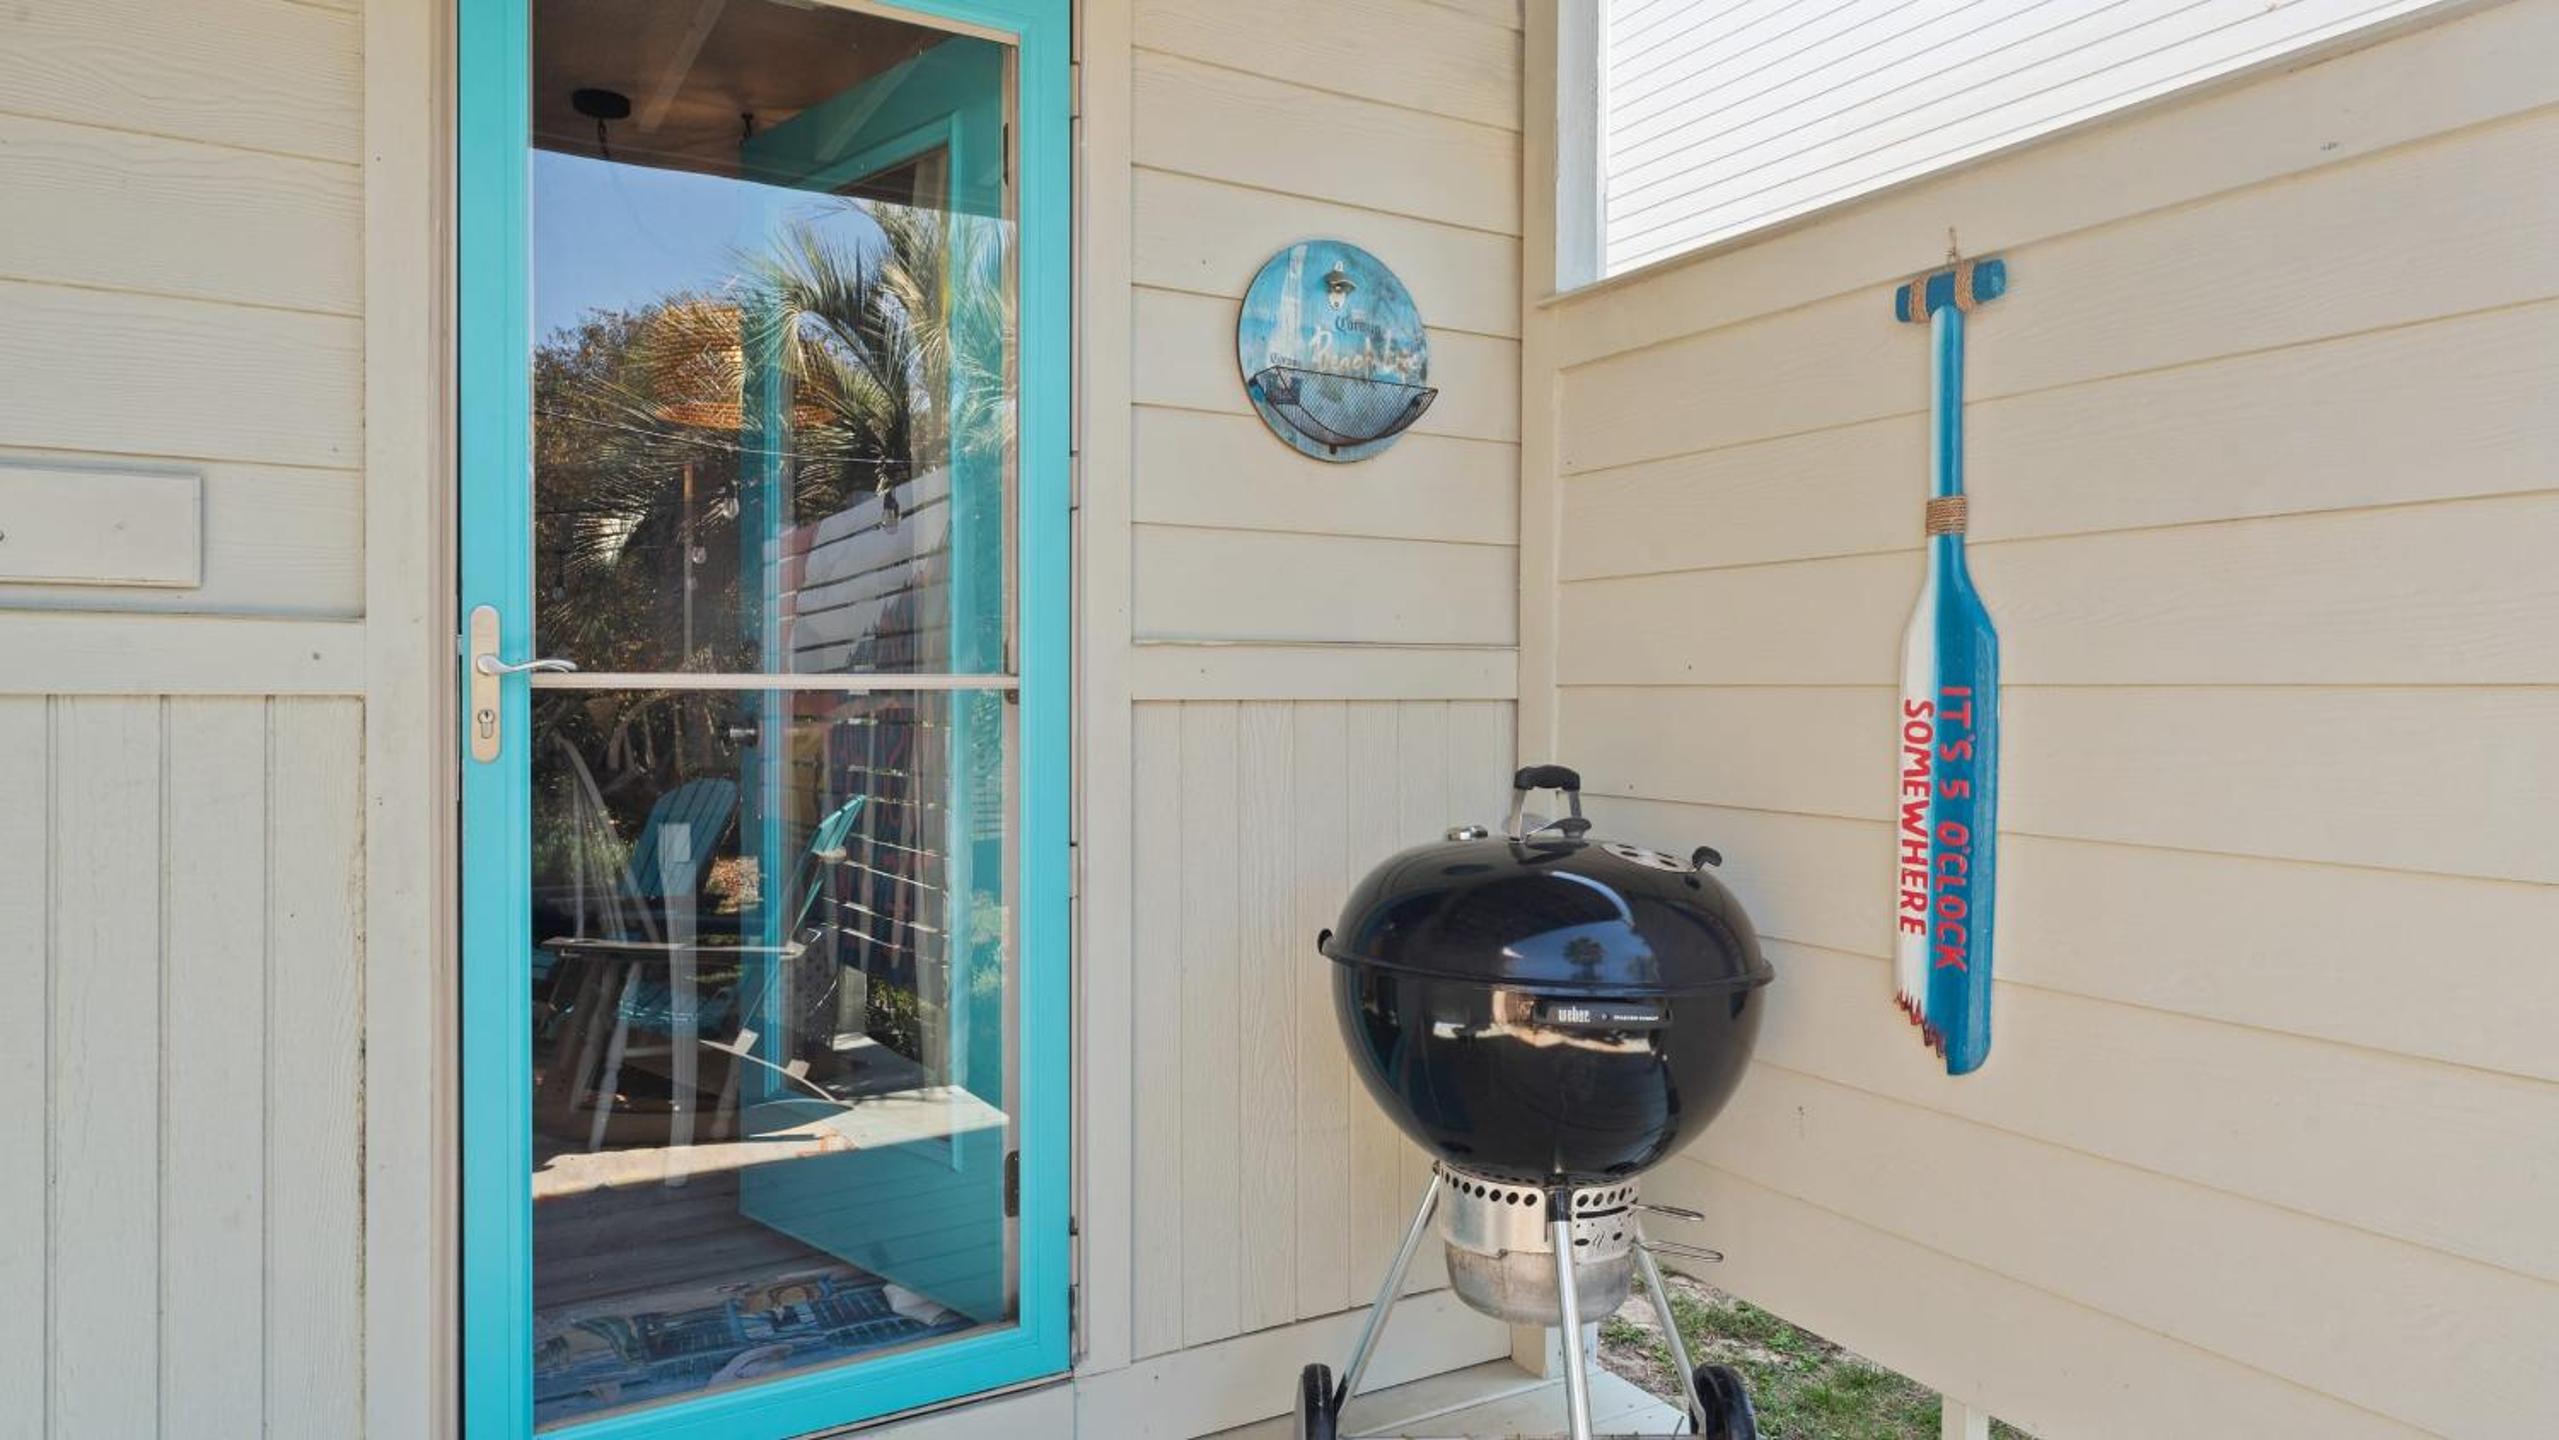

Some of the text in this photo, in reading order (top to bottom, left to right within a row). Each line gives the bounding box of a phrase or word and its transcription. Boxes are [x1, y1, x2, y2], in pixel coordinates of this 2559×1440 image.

[1899, 698, 1935, 936] SOMEWHERE
[1935, 686, 1976, 972] IT'S 5 O'CLOCK
